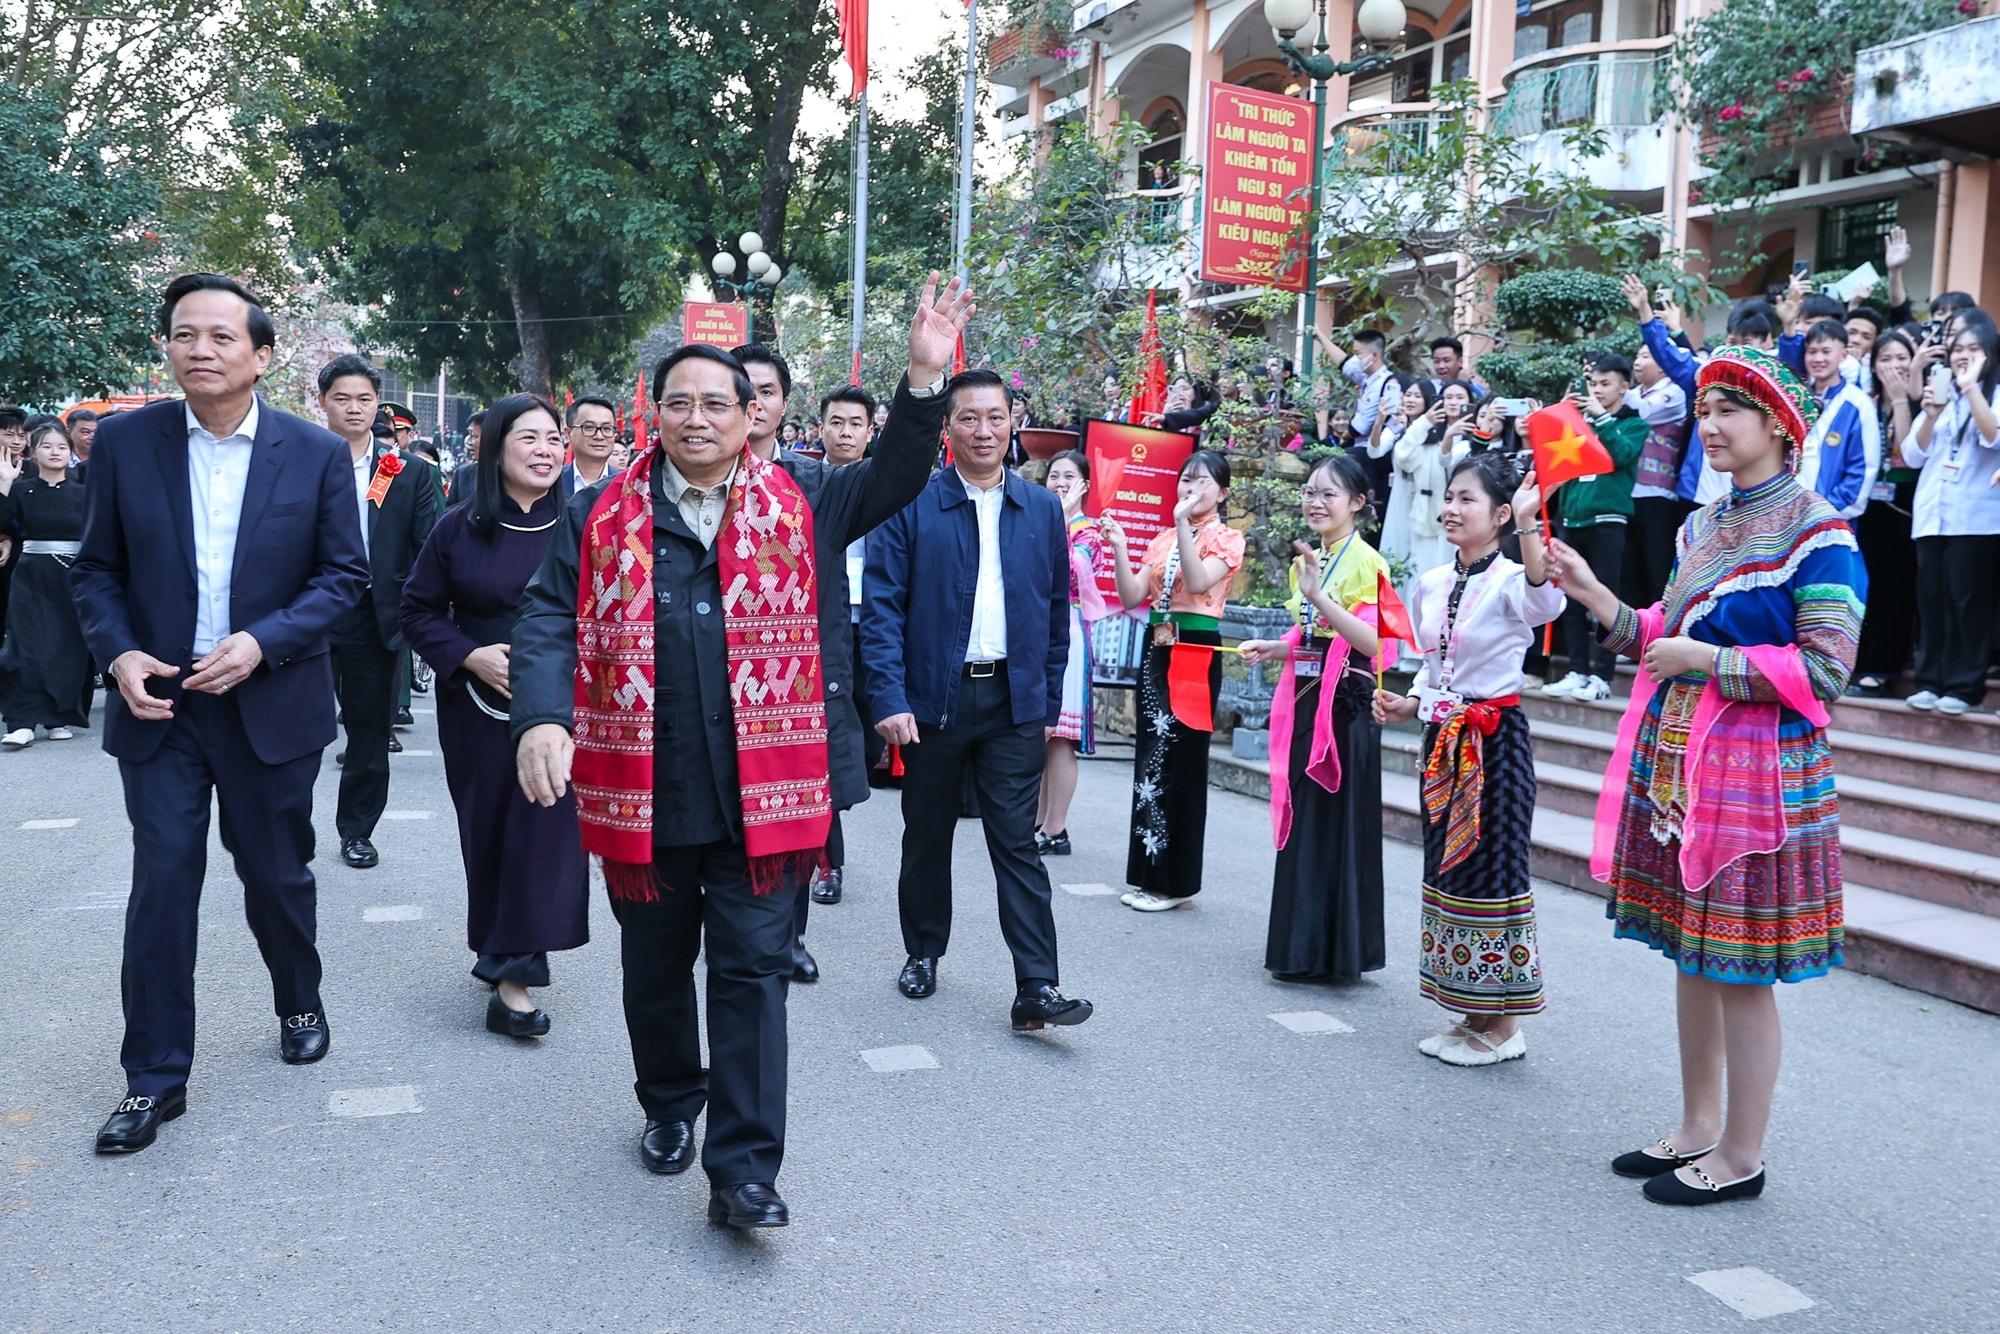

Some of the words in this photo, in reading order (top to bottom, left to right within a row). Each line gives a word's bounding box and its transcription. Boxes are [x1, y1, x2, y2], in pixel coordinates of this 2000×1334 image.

[1261, 107, 1296, 128] THỨC
[1215, 121, 1246, 143] LÀM
[1248, 130, 1290, 151] NGƯỜI
[1291, 136, 1307, 155] TA
[1224, 149, 1268, 172] KHIÊM
[1270, 154, 1297, 177] TỐN
[1237, 176, 1266, 196] NGU
[1268, 182, 1283, 199] SI
[1212, 195, 1242, 217] LÀM
[1245, 203, 1286, 224] NGƯỜI
[1288, 209, 1304, 226] TA
[1218, 222, 1250, 242] KIÊU
